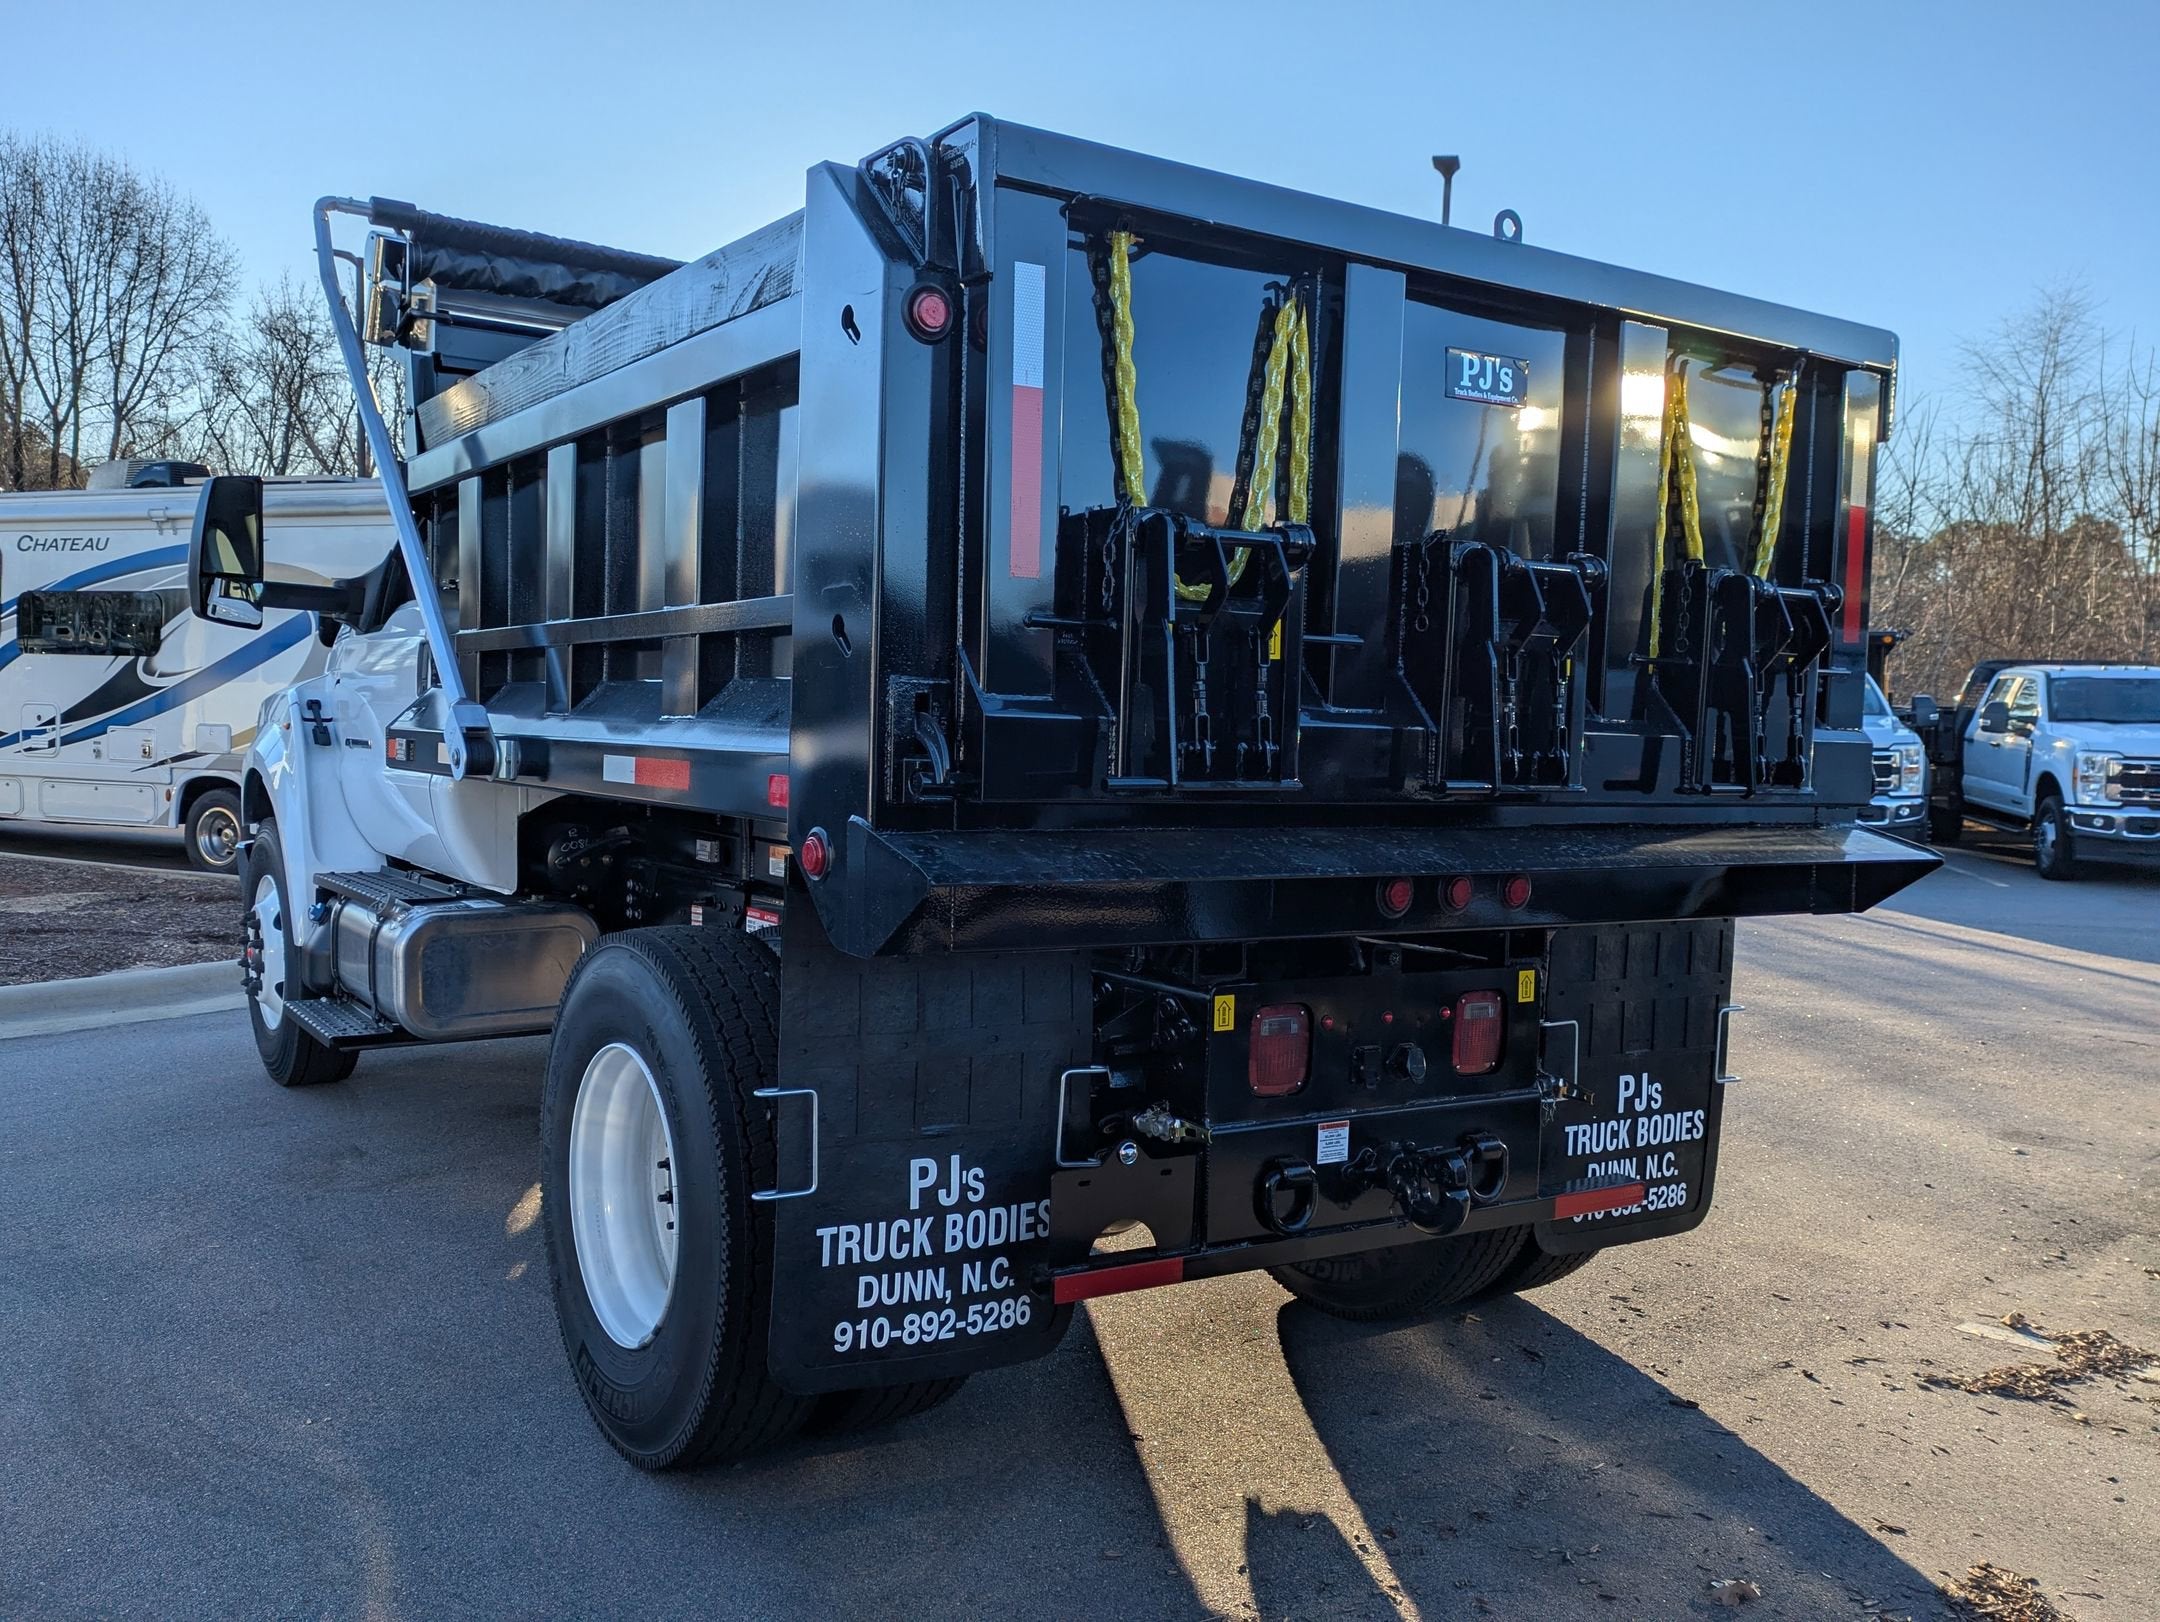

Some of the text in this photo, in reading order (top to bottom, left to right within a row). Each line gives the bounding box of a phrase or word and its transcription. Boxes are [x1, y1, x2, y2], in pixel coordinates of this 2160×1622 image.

[1454, 387, 1468, 396] Truck
[1468, 389, 1483, 399] Bodies
[1488, 392, 1511, 404] Equipment
[1460, 351, 1513, 393] PJ's
[1617, 1072, 1662, 1114] PJ's
[1564, 1109, 1705, 1157] TRUCK BODIES
[909, 1154, 986, 1211] PJ's
[1646, 1152, 1679, 1180] N.C.
[816, 1198, 1051, 1268] TRUCK BODIES
[857, 1256, 1016, 1309] DUNN, N.C.
[833, 1294, 1031, 1353] 910-892-5286
